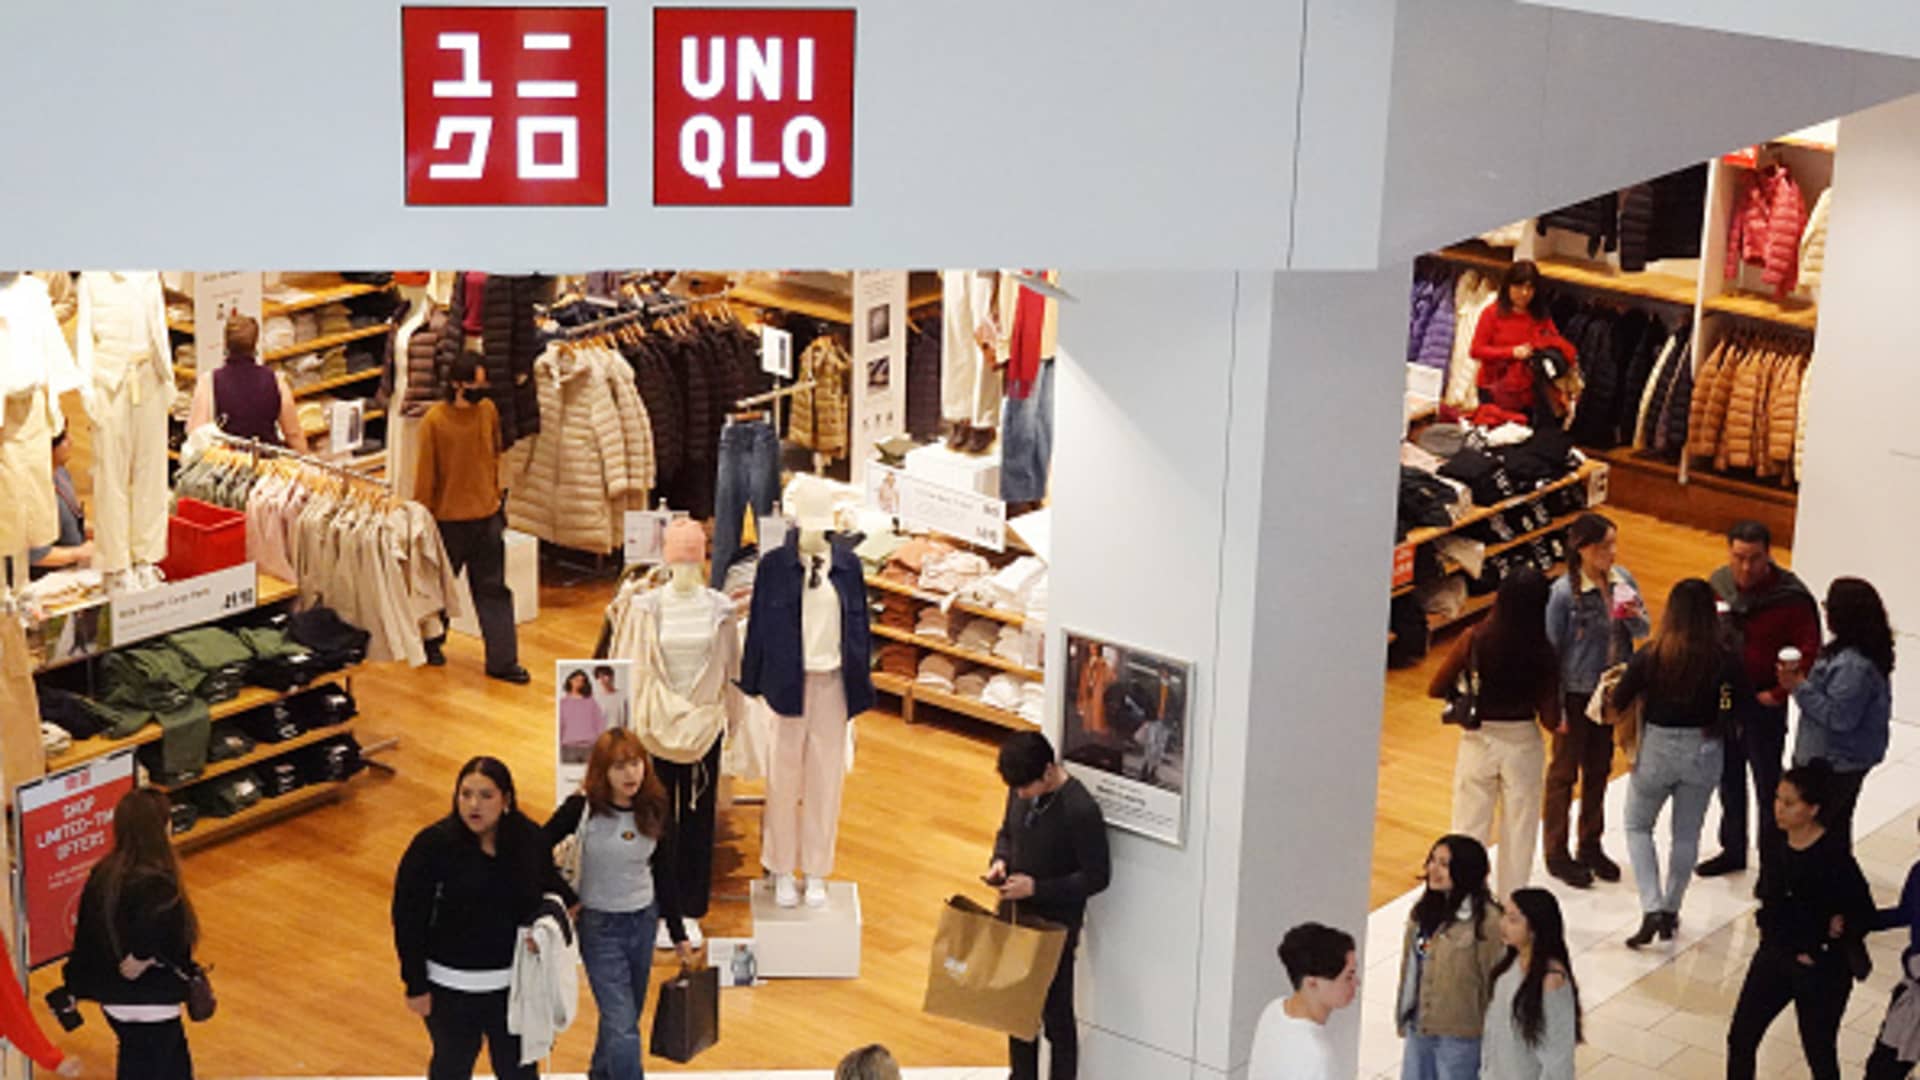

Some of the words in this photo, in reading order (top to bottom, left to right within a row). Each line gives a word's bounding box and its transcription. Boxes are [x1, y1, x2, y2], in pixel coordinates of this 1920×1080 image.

[432, 33, 578, 98] ユニ
[681, 36, 815, 101] UNI
[428, 115, 579, 180] クロ
[679, 114, 827, 189] QLO
[63, 795, 95, 819] SHOP
